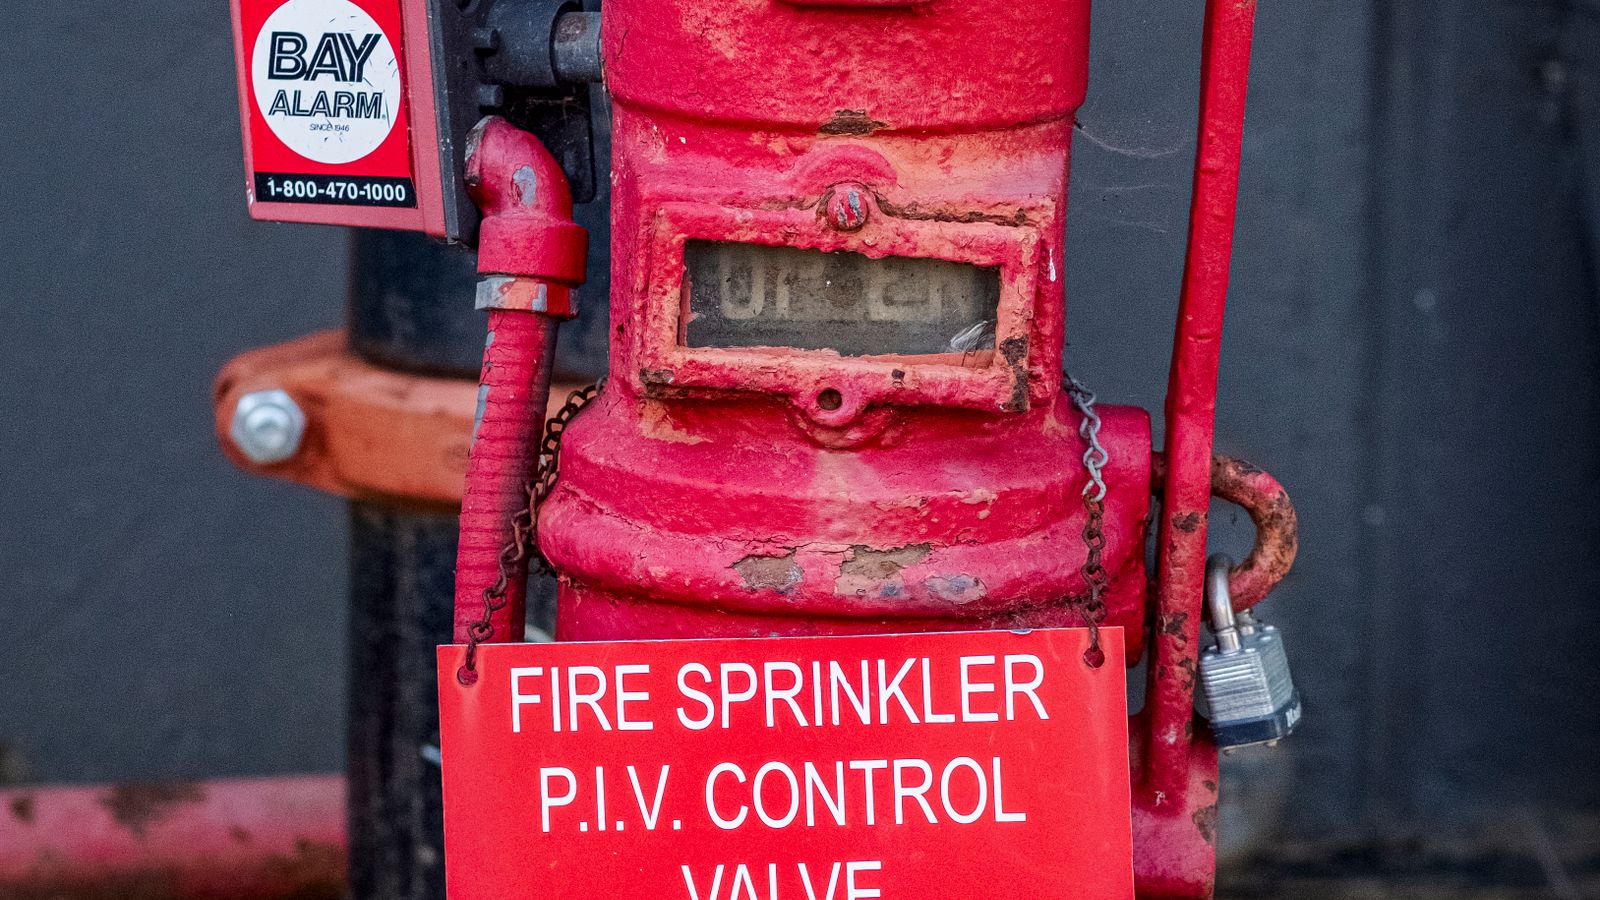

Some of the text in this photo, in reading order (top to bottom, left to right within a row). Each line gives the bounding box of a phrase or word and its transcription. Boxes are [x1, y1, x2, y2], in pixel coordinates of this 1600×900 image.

[267, 31, 382, 83] BAY
[268, 89, 383, 119] ALARM
[309, 123, 350, 133] SINCE 1946
[267, 180, 406, 201] 1-800-470-1000
[510, 654, 1050, 733] FIRE SPRINKLER
[539, 756, 1027, 833] P.I.V. CONTROL
